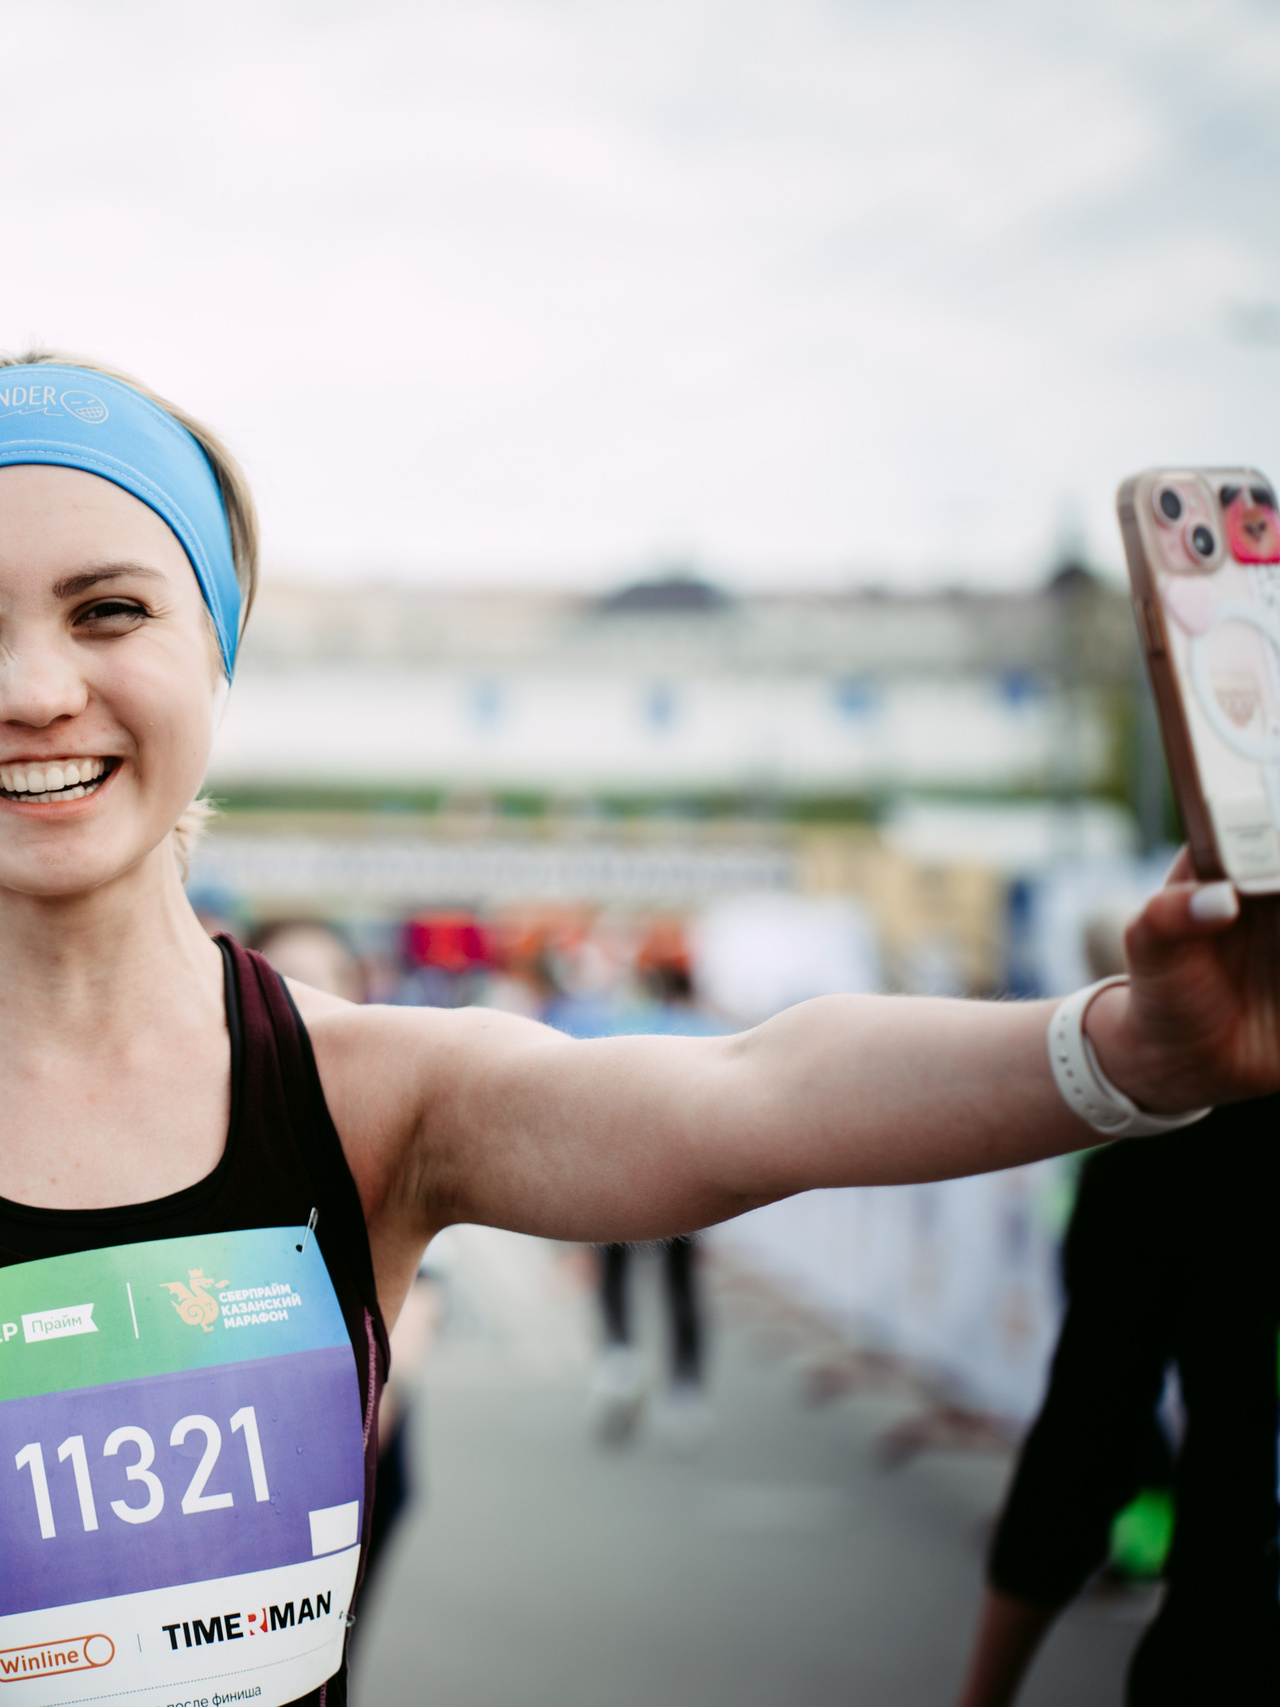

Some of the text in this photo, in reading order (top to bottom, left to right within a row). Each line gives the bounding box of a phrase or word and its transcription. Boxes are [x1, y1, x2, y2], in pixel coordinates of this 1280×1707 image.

[218, 1282, 292, 1304] СБЕРПРАЙМ
[220, 1292, 302, 1317] КАЗАНСКИЙ
[30, 1314, 82, 1335] Прайм
[223, 1309, 289, 1330] МАРАФОН
[14, 1405, 271, 1540] 11321
[162, 1590, 333, 1651] TIMERMAN
[0, 1648, 79, 1675] Winline
[212, 1685, 262, 1707] финиша
